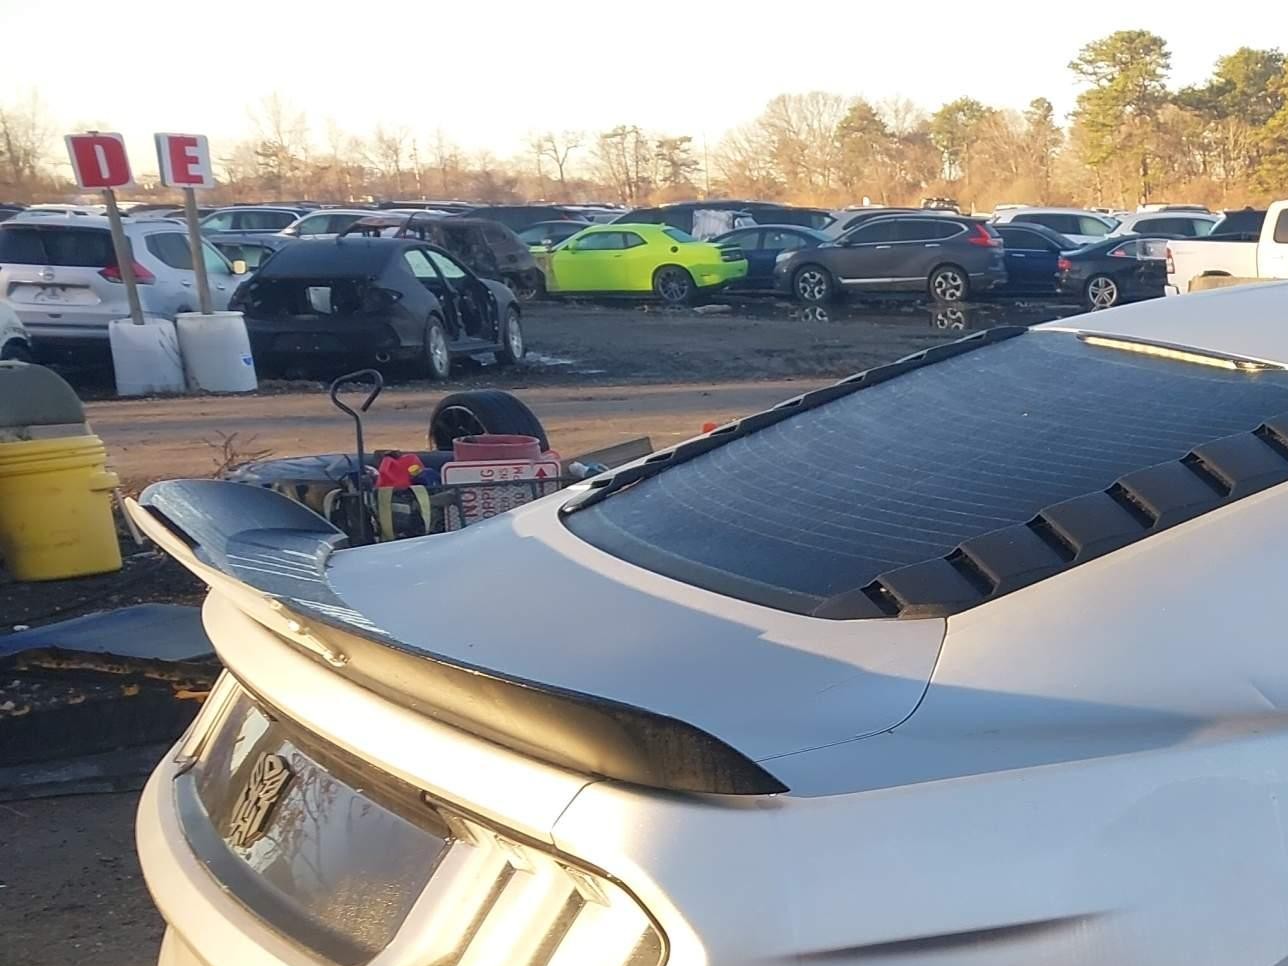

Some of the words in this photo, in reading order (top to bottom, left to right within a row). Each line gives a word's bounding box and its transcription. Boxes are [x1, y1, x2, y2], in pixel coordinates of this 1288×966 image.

[71, 136, 130, 187] D
[167, 136, 204, 184] E
[463, 488, 478, 518] NO
